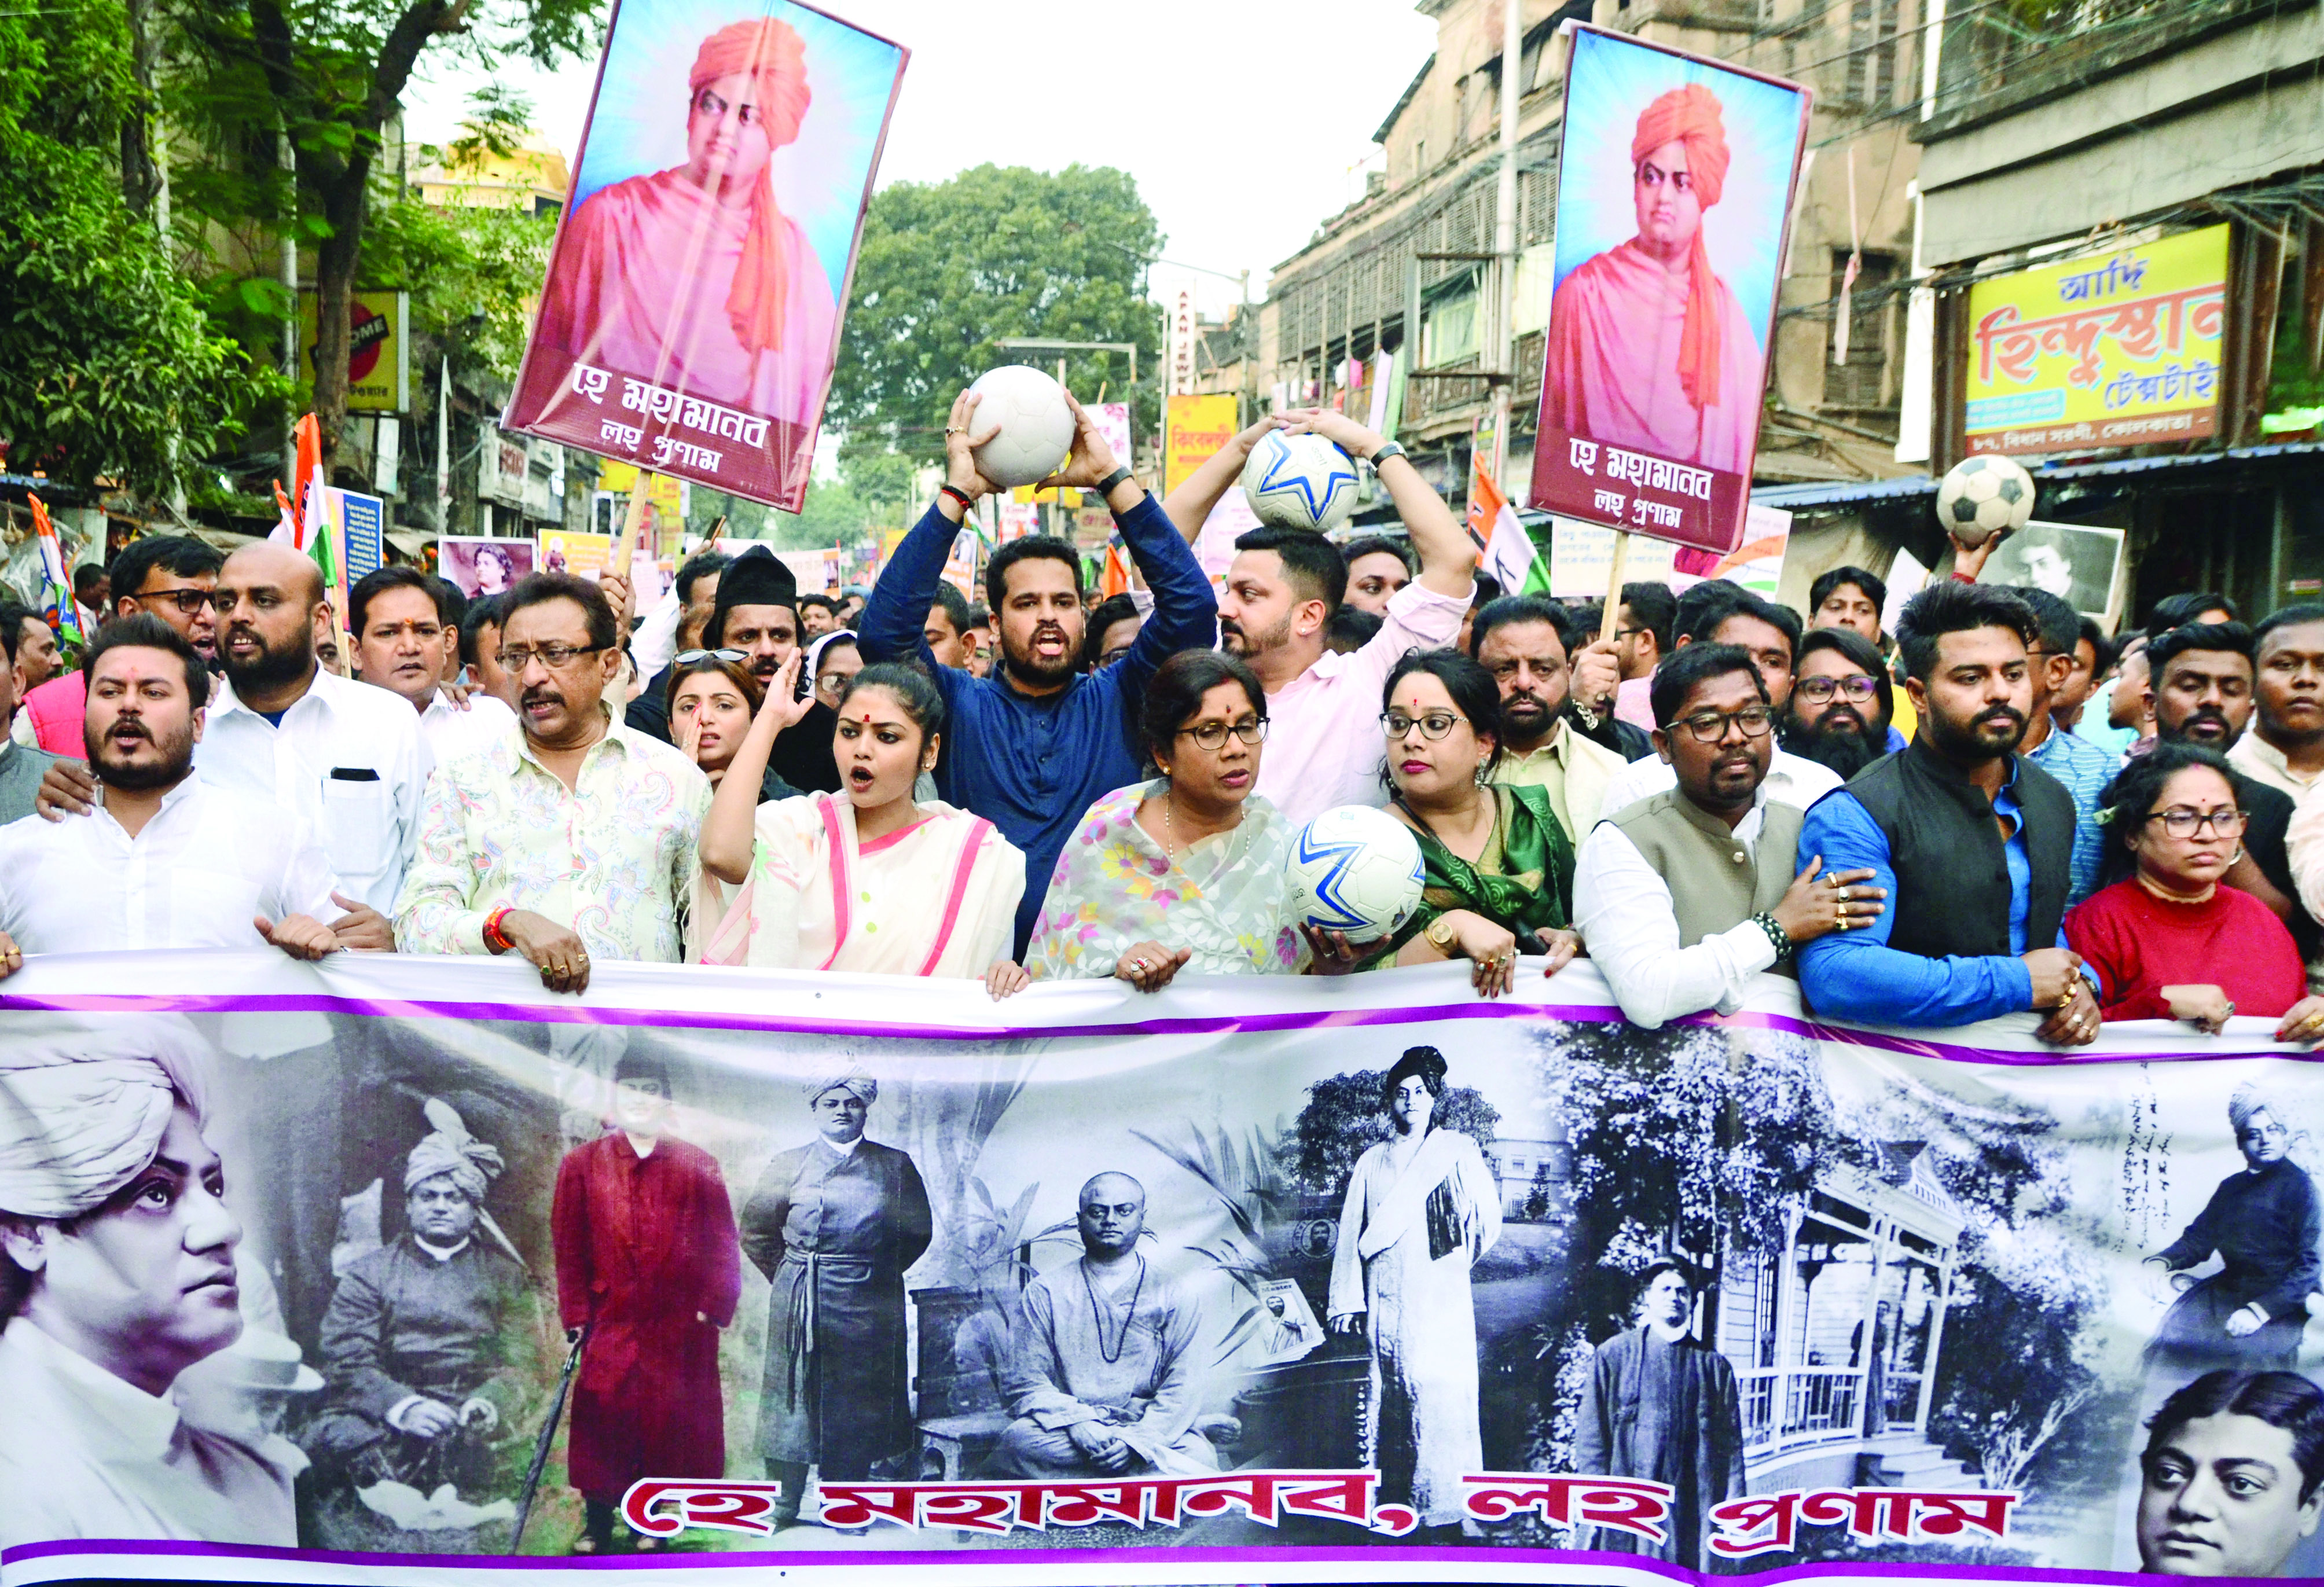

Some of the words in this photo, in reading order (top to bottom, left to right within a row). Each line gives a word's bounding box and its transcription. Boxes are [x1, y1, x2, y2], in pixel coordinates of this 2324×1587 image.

[572, 362, 612, 404] হে
[622, 377, 770, 449] মহামানব
[2105, 360, 2220, 409] টেক্সটাই
[600, 419, 644, 451] লহ
[652, 435, 723, 472] প্রণাম
[1570, 437, 1598, 476] হে
[1606, 447, 1713, 500] মহামানব
[1594, 489, 1626, 517] লহ
[1632, 498, 1683, 528] প্রণাম
[621, 1478, 781, 1537] হে
[818, 1469, 1420, 1537] মহামানব,
[1456, 1471, 1676, 1546] লহ
[1706, 1486, 2022, 1557] প্রণাম
